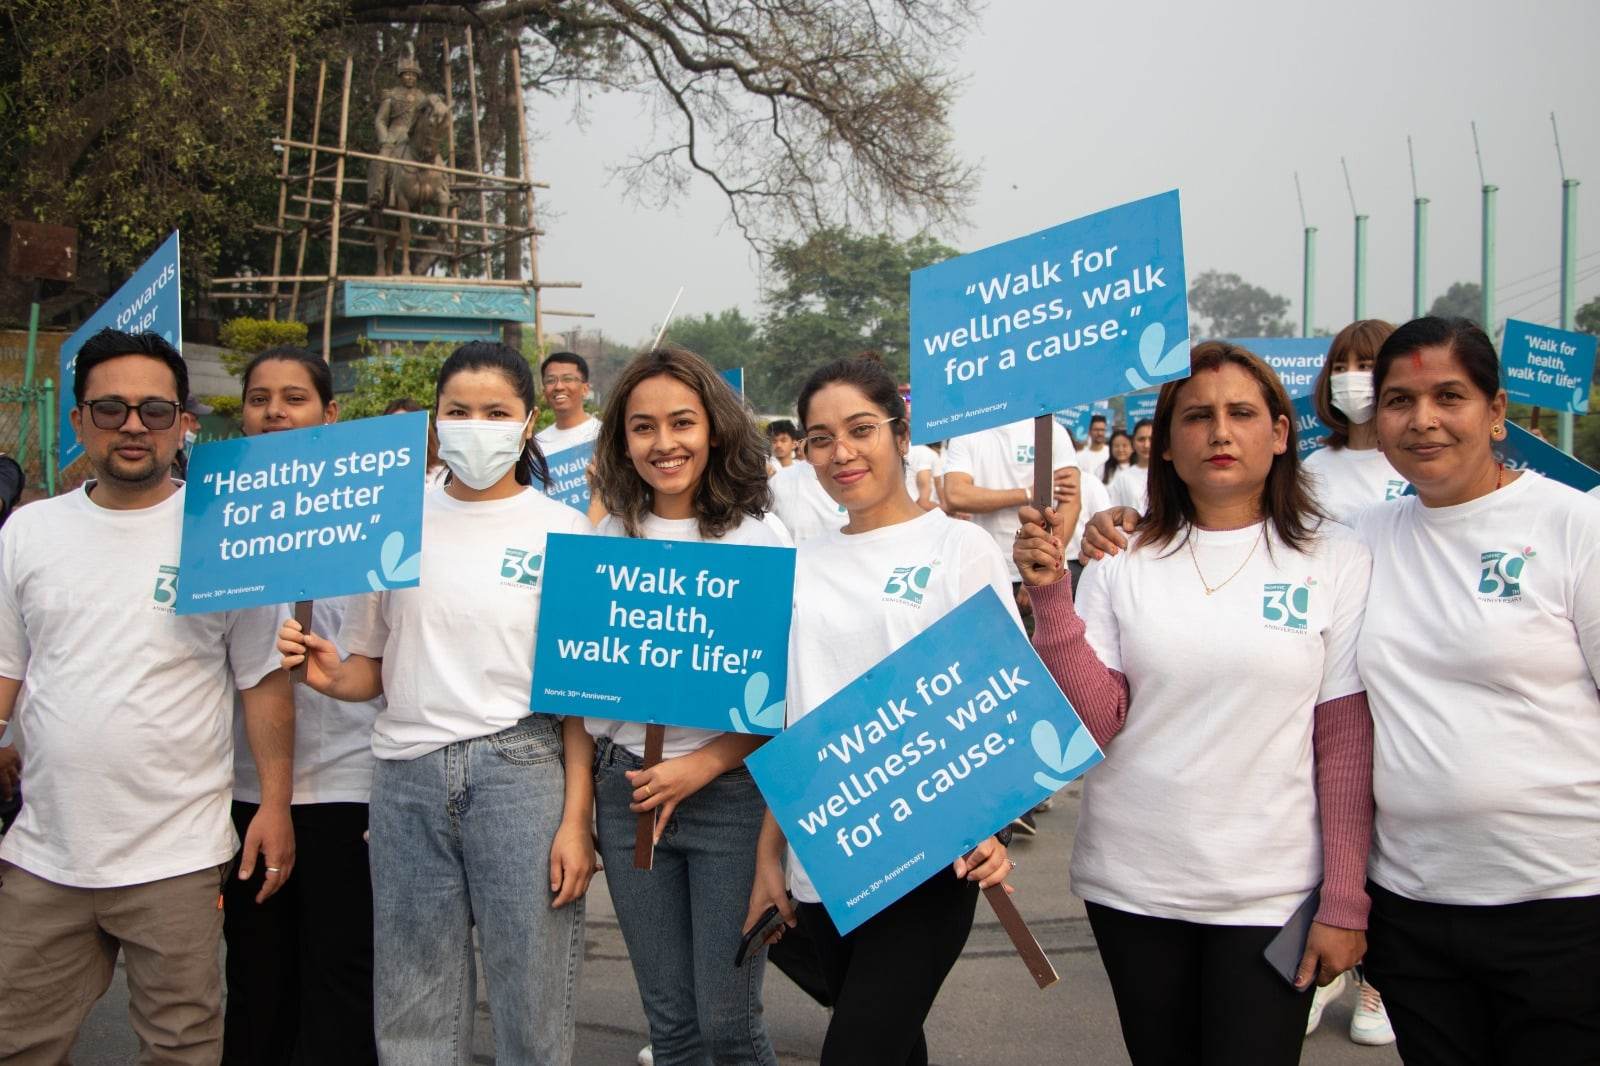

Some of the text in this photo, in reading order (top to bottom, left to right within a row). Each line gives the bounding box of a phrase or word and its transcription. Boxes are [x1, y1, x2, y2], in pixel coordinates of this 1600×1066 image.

[117, 263, 175, 329] towards
[965, 245, 1118, 305] “Walk for
[923, 263, 1167, 356] wellness, walk
[943, 305, 1142, 386] for a cause.”
[1524, 334, 1577, 357] “Walk for
[1527, 352, 1566, 372] health,
[1507, 366, 1535, 381] walk
[1537, 370, 1554, 385] for
[926, 417, 949, 429] Norvic
[964, 401, 1008, 418] Anniversary
[203, 446, 411, 496] “Healthy steps
[222, 484, 385, 527] for a better
[219, 513, 381, 561] tomorrow.”
[192, 592, 213, 600] Norvic
[227, 584, 265, 596] Anniversary
[595, 563, 740, 599] “Walk for
[609, 600, 715, 640] health,
[557, 636, 763, 675] walk for life!”
[544, 688, 566, 697] Norvic
[581, 691, 622, 703] Anniversary
[817, 661, 963, 765] “Walk for
[797, 665, 1031, 836] wellness, walk
[836, 710, 1018, 857] for a cause.”
[846, 888, 871, 908] Norvic
[884, 850, 925, 881] Anniversary
